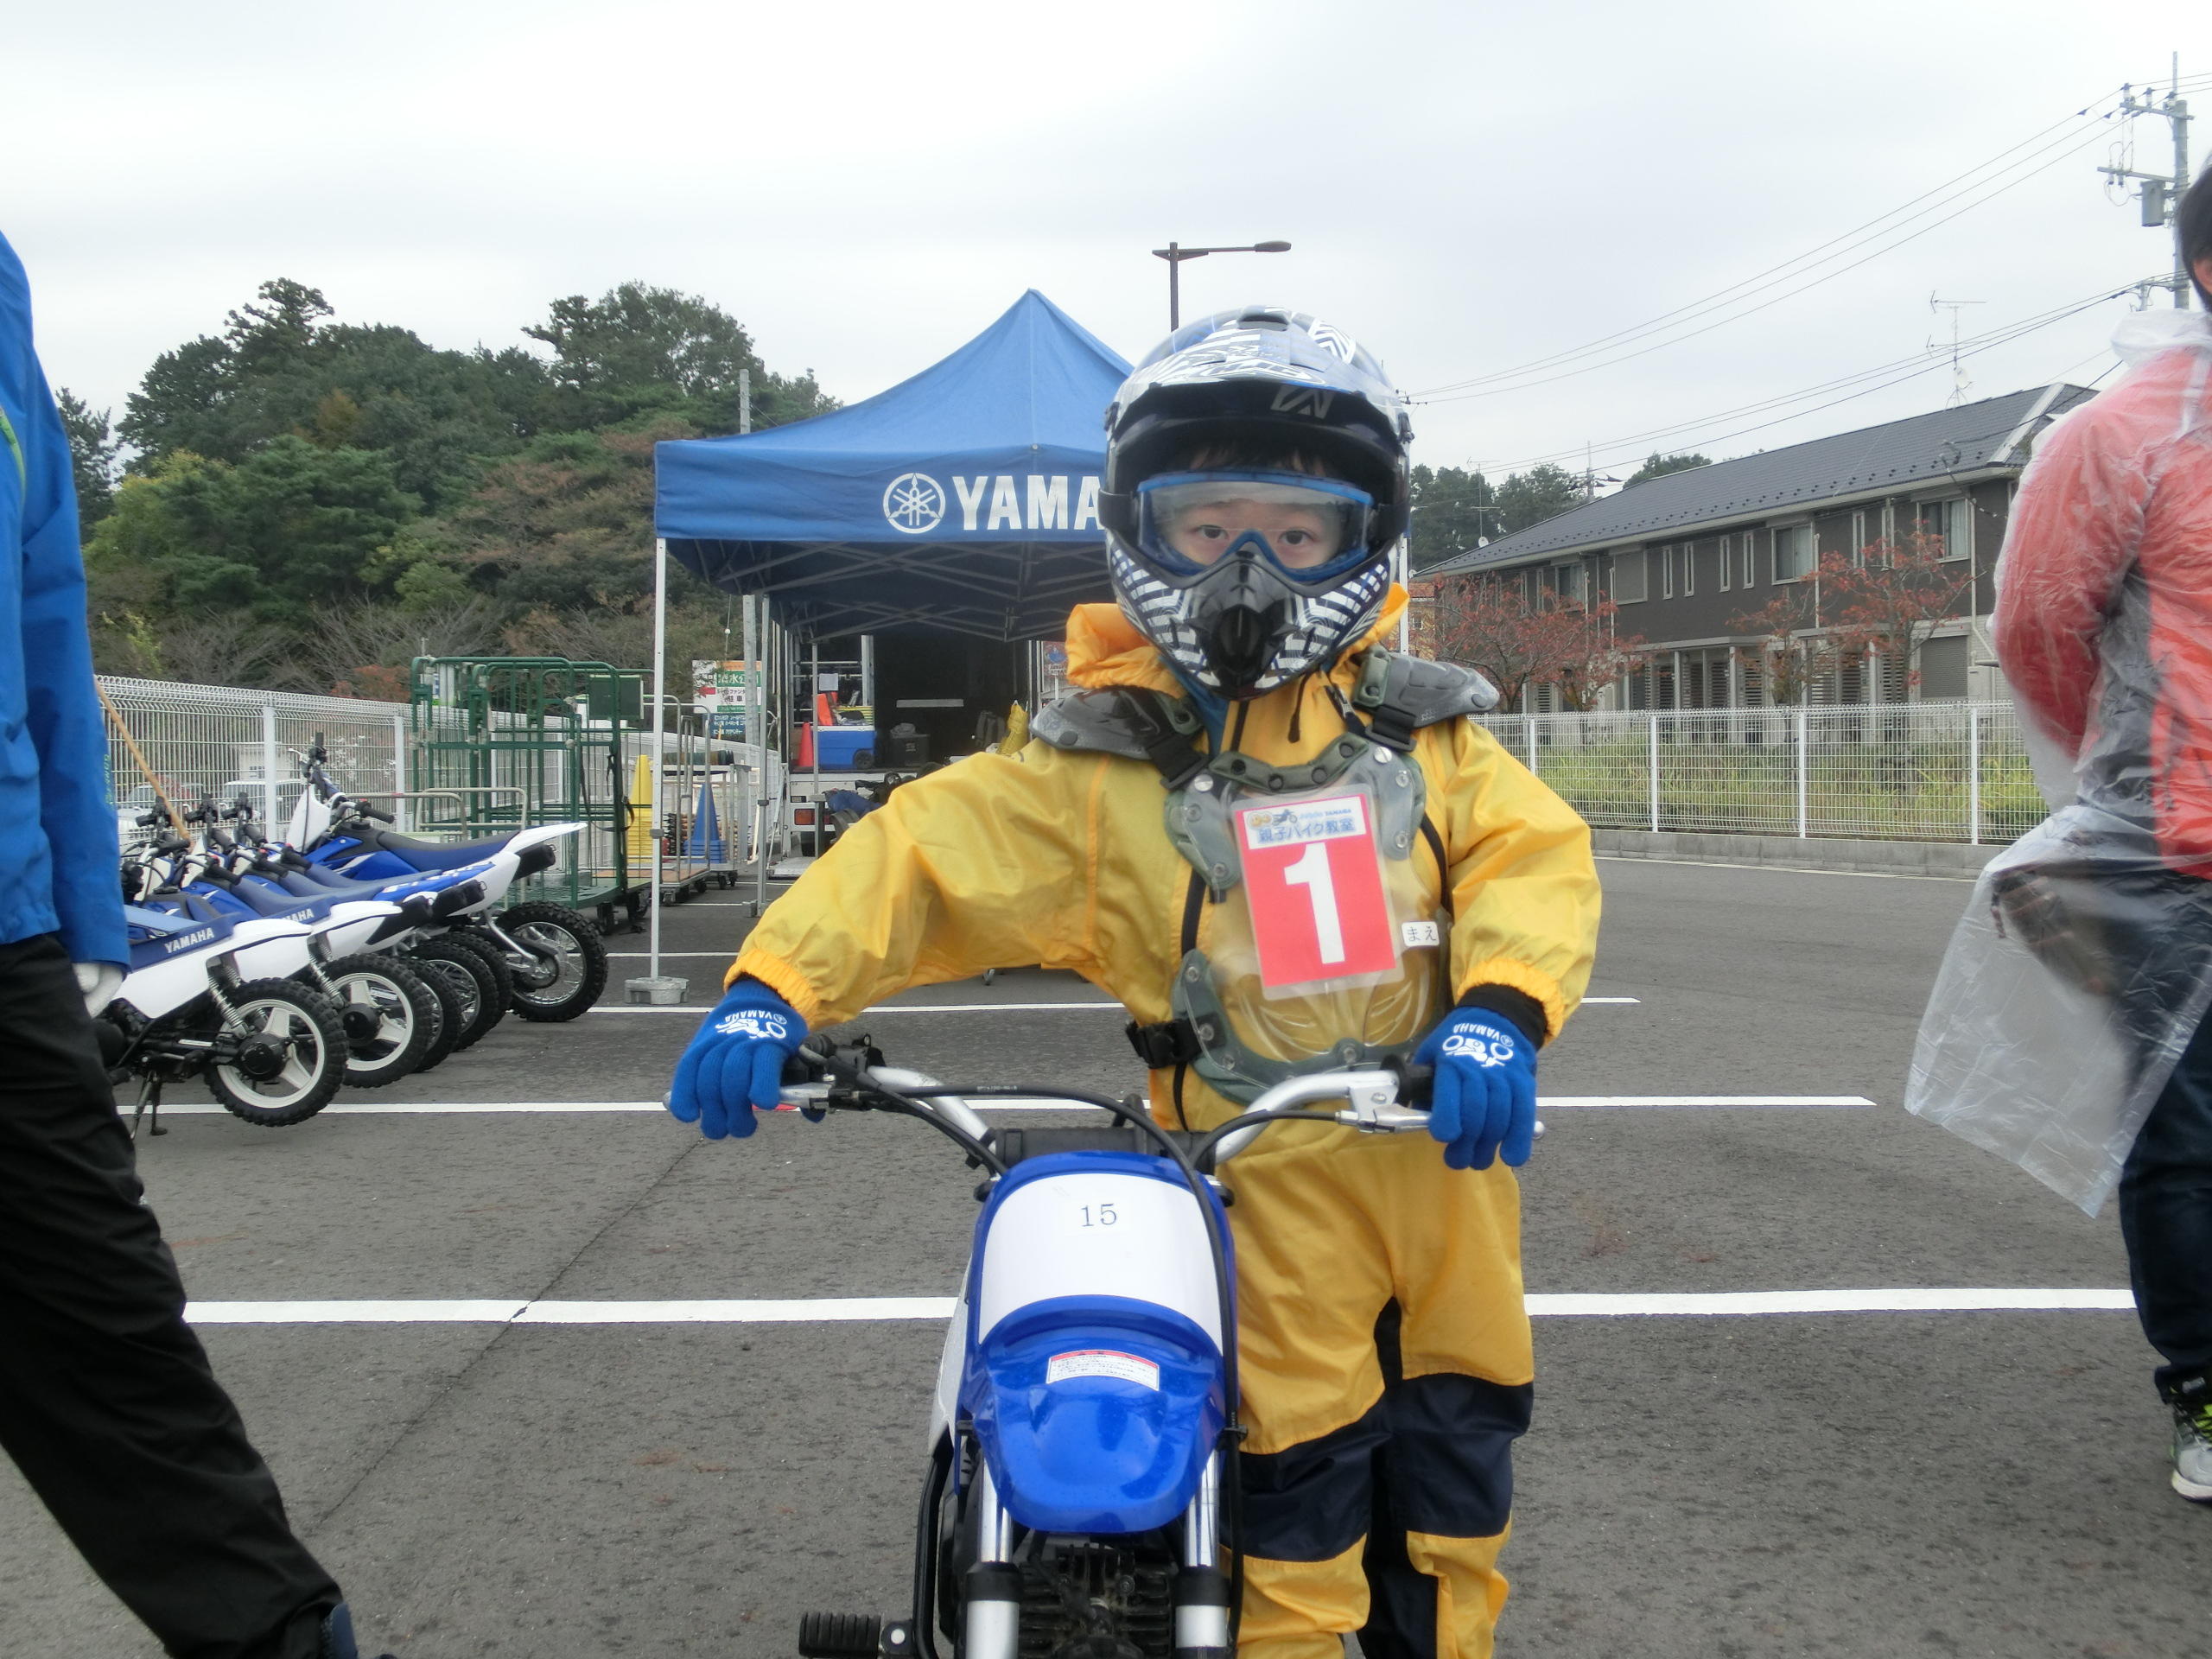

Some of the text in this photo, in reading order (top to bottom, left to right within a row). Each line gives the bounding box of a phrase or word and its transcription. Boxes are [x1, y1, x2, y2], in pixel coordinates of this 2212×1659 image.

[1258, 818, 1355, 843] 親子バイク教室
[1284, 842, 1345, 964] 1
[164, 927, 215, 954] YAMAHA
[724, 1009, 773, 1023] YAMAHA
[1452, 1022, 1501, 1041] YAMAHA
[1080, 1203, 1117, 1227] 15
